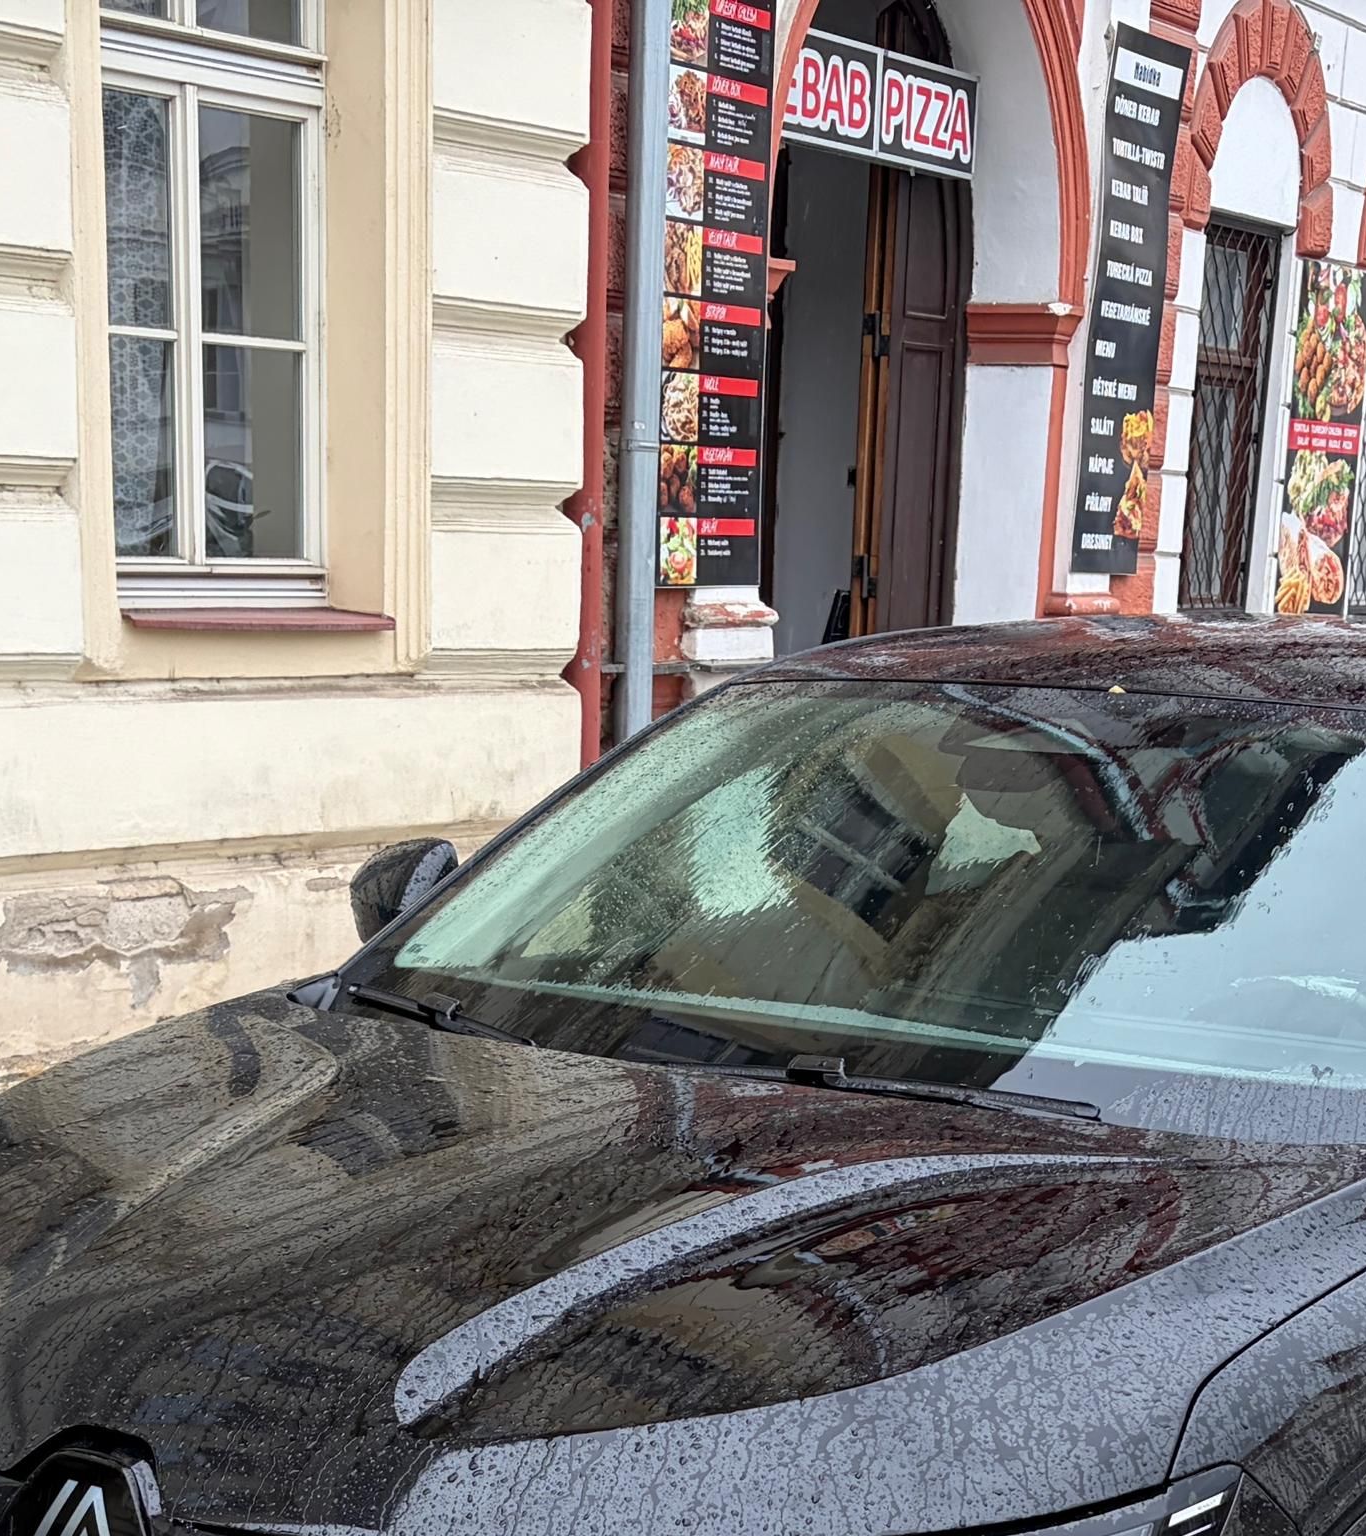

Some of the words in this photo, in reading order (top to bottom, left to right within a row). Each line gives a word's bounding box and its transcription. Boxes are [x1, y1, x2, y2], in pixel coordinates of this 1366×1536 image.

[884, 77, 969, 155] PIZZA
[1114, 94, 1137, 119] DÖNER
[1138, 104, 1161, 126] KEBAB
[1111, 179, 1131, 200] KEBAB
[1109, 219, 1130, 241] KEBAB
[1131, 225, 1144, 244] BOX
[1106, 260, 1134, 283] TURECKÁ
[1135, 267, 1153, 287] PIZZA
[1095, 339, 1116, 358] MENU
[1092, 376, 1117, 398] DĚTSKÉ
[1117, 382, 1137, 402] MENU
[1091, 415, 1114, 436] SALÁTY
[1088, 453, 1114, 475] NÁPOJE
[1085, 492, 1113, 513] PŘÍLOHY
